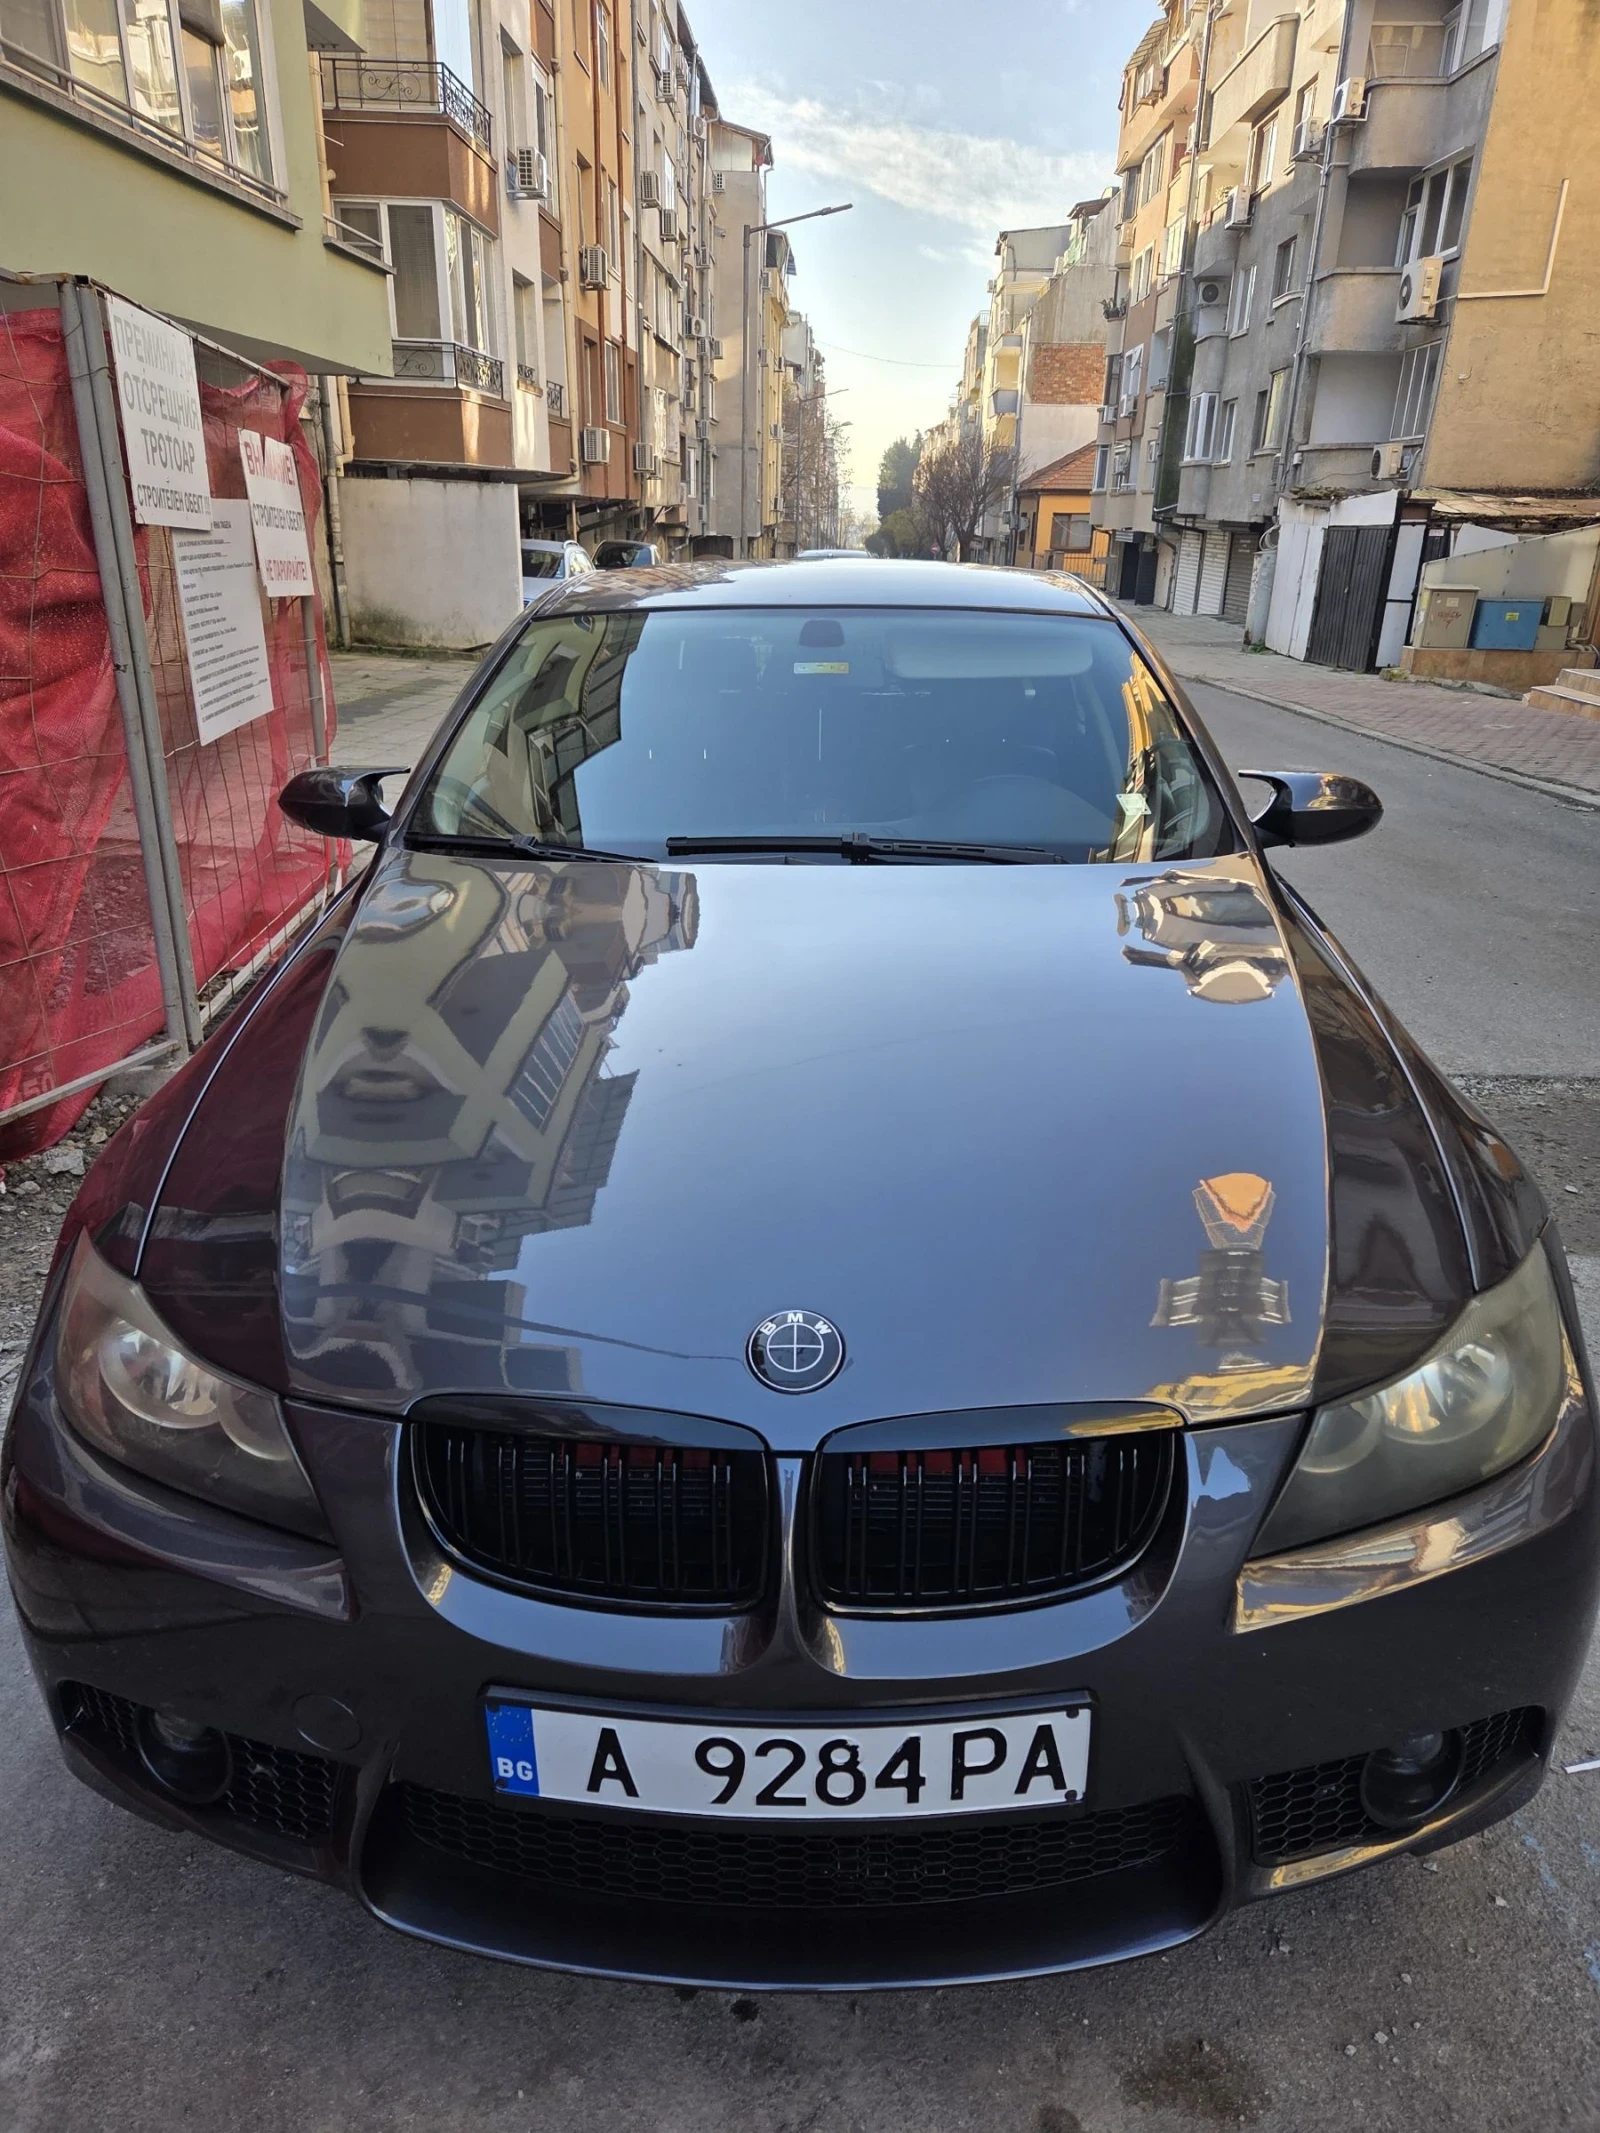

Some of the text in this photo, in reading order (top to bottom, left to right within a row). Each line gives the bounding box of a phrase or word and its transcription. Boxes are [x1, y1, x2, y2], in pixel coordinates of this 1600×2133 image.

[113, 314, 178, 377] ПРЕМИНИ
[123, 370, 200, 432] ОТСРЕЩНИЯ
[140, 427, 196, 475] ТРОТОАР
[136, 483, 184, 511] СТРОИТЕЛЕН
[183, 491, 204, 514] ОБЕКТ
[252, 503, 286, 529] СТРОИТЕЛЕН
[760, 1312, 832, 1336] BMW
[497, 1758, 534, 1782] BG
[586, 1728, 640, 1798] A
